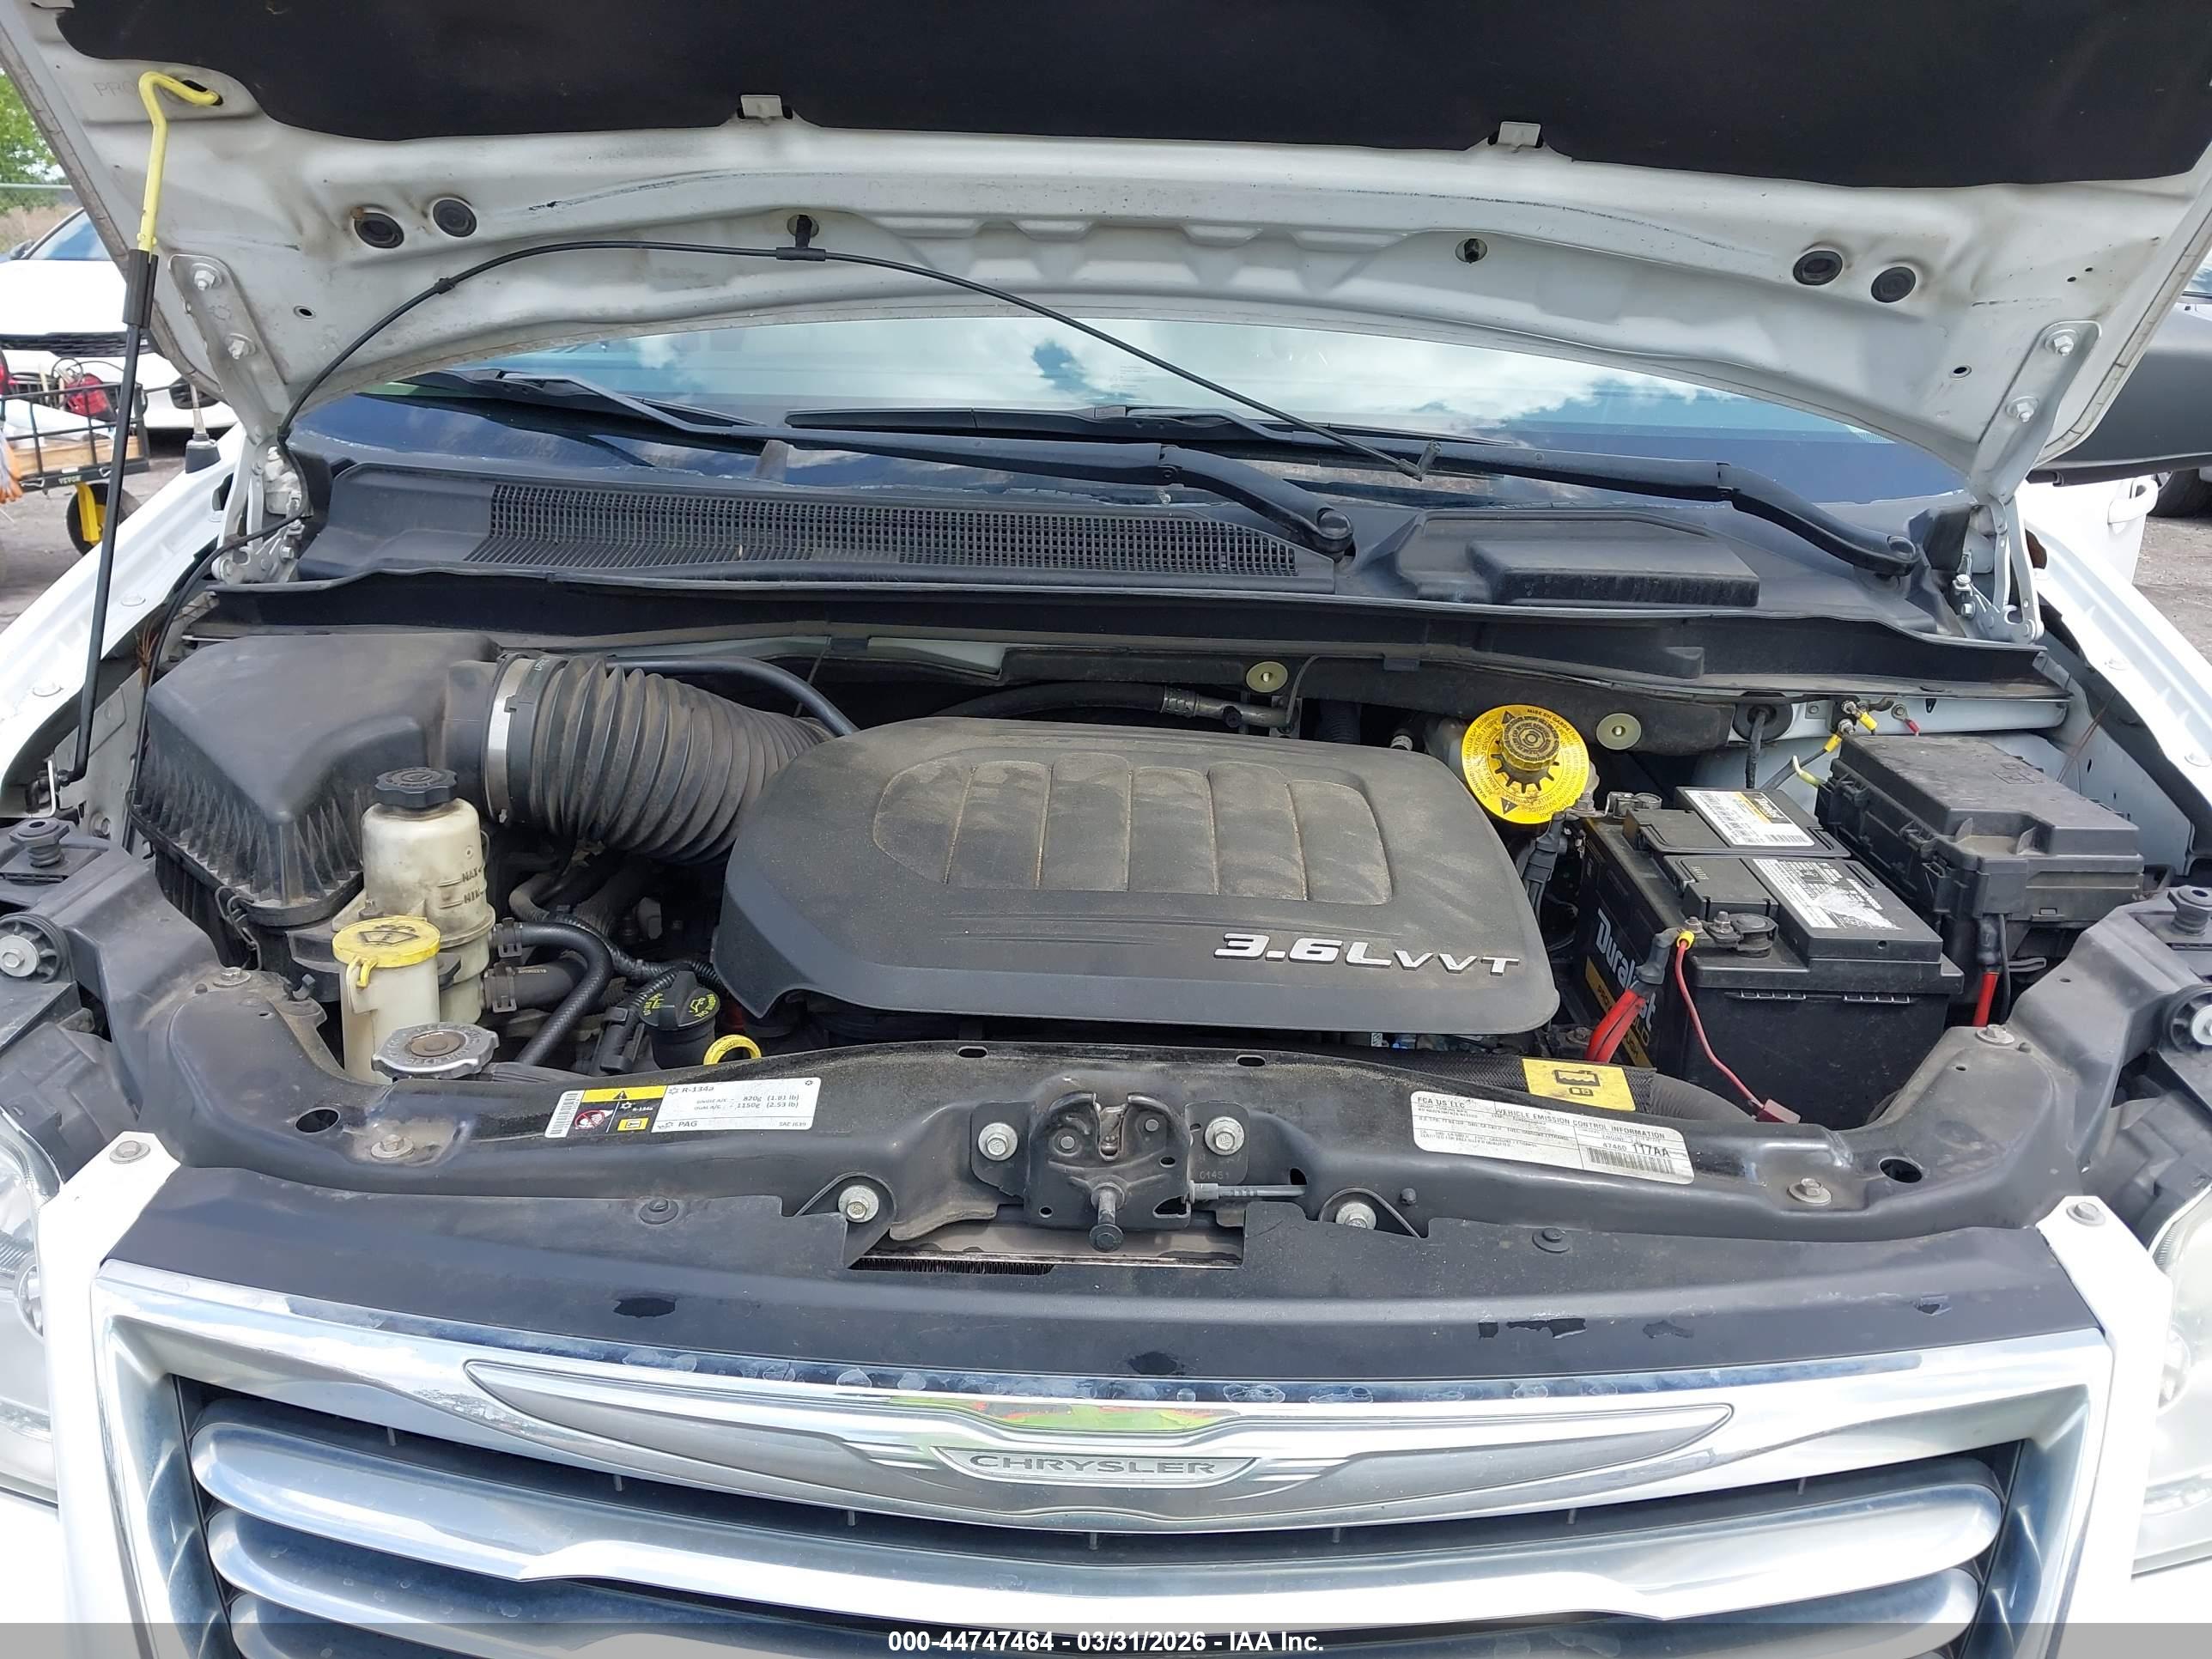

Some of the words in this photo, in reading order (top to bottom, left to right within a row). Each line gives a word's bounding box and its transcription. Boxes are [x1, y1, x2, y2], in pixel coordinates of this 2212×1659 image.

[1214, 933, 1392, 968] 3.6L
[1395, 950, 1520, 976] VVT
[1498, 1108, 1533, 1119] VEHICLE
[1533, 1114, 1571, 1125] EMISSION
[1573, 1119, 1610, 1131] CONTROL
[1611, 1126, 1665, 1139] INFORMATION
[969, 1455, 1216, 1474] CHRYSLER
